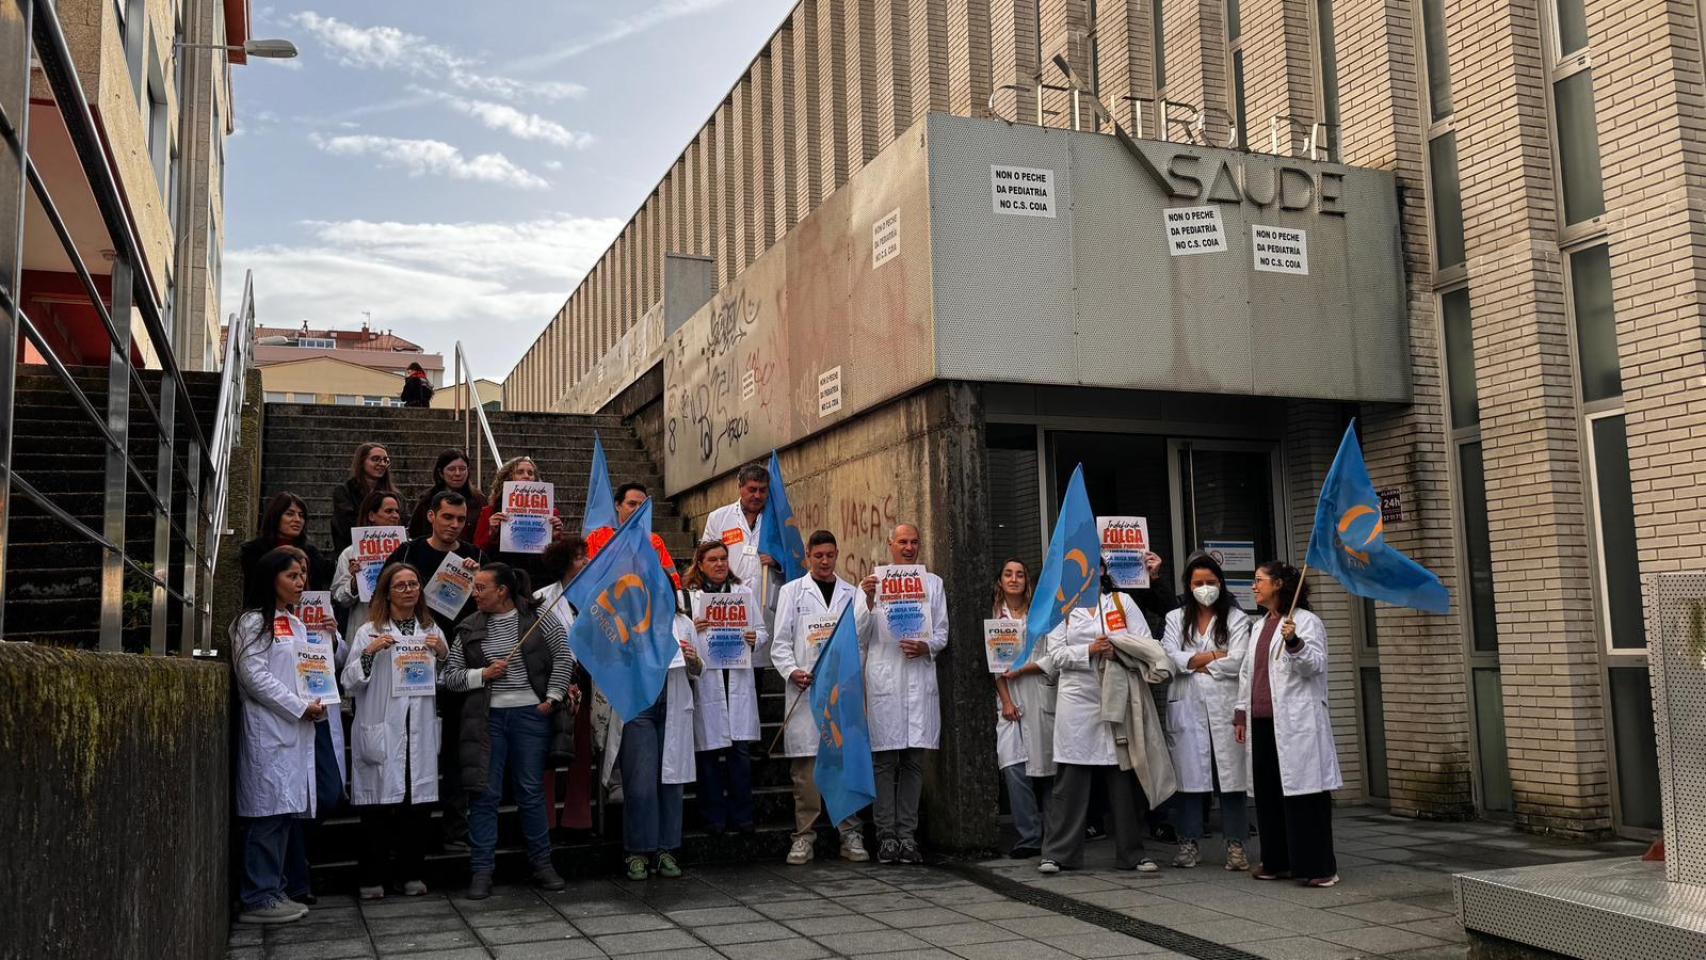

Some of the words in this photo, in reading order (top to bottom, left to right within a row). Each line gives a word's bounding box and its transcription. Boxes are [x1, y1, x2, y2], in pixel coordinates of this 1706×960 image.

[995, 170, 1012, 180] NON
[1014, 171, 1020, 180] O
[1022, 172, 1046, 183] PECHE
[996, 185, 1007, 194] DA
[1000, 199, 1011, 209] NO
[1013, 200, 1027, 210] C.S.
[1029, 201, 1047, 211] COIA
[1168, 213, 1183, 222] NON
[1185, 212, 1190, 221] O
[1192, 210, 1214, 220] PECHE
[1171, 227, 1180, 236] DA
[1256, 230, 1270, 239] NON
[1272, 231, 1277, 240] O
[1278, 232, 1300, 242] PECHE
[1176, 241, 1186, 249] NO
[1188, 240, 1201, 248] C.S.
[1202, 238, 1219, 247] COIA
[1257, 243, 1266, 252] DA
[1260, 257, 1270, 265] NO
[1271, 258, 1284, 267] C.S.
[1285, 260, 1301, 269] COIA
[508, 493, 548, 508] FOLGA
[1103, 528, 1143, 543] FOLGA
[445, 562, 474, 582] FOLGA
[881, 577, 923, 594] FOLGA
[705, 605, 747, 621] FOLGA
[297, 651, 327, 661] FOLGA
